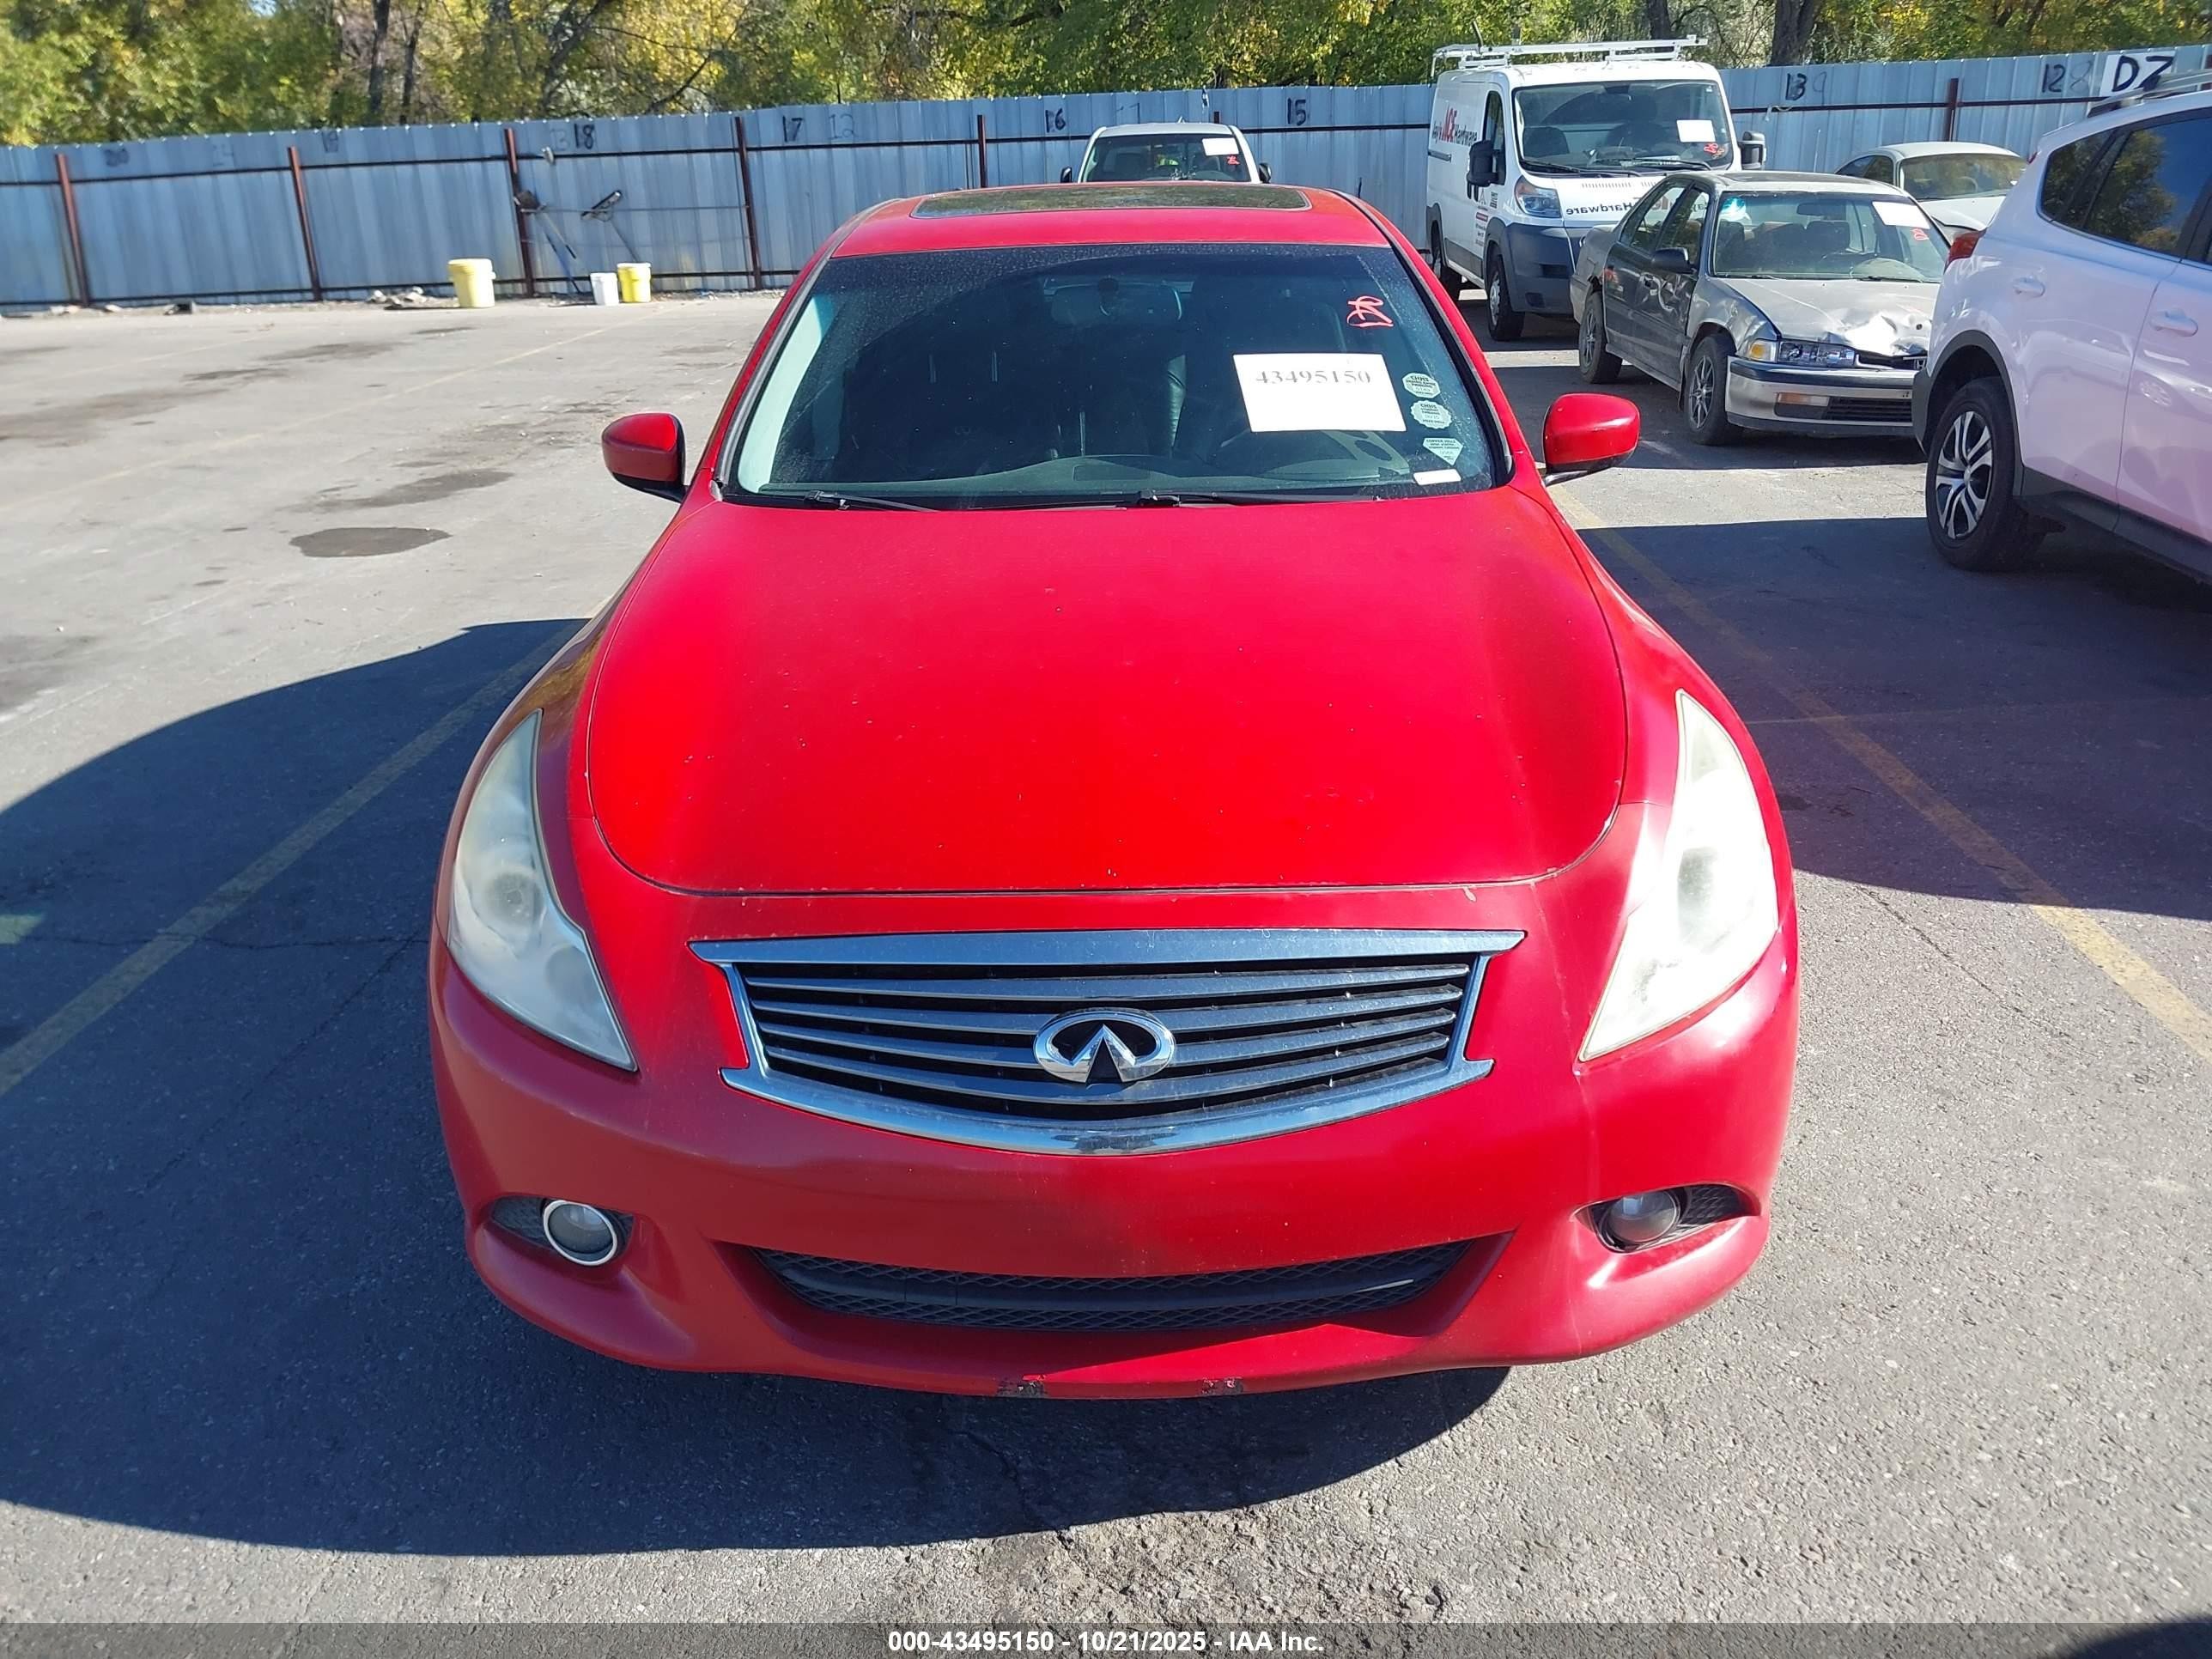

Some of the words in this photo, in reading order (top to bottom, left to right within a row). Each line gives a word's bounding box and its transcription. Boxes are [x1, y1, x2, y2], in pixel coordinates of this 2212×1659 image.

[2042, 64, 2066, 93] 12
[1045, 107, 1066, 133] 16
[1287, 97, 1307, 126] 15
[574, 123, 595, 149] 18
[782, 115, 805, 143] 17
[1256, 370, 1371, 384] 43495150
